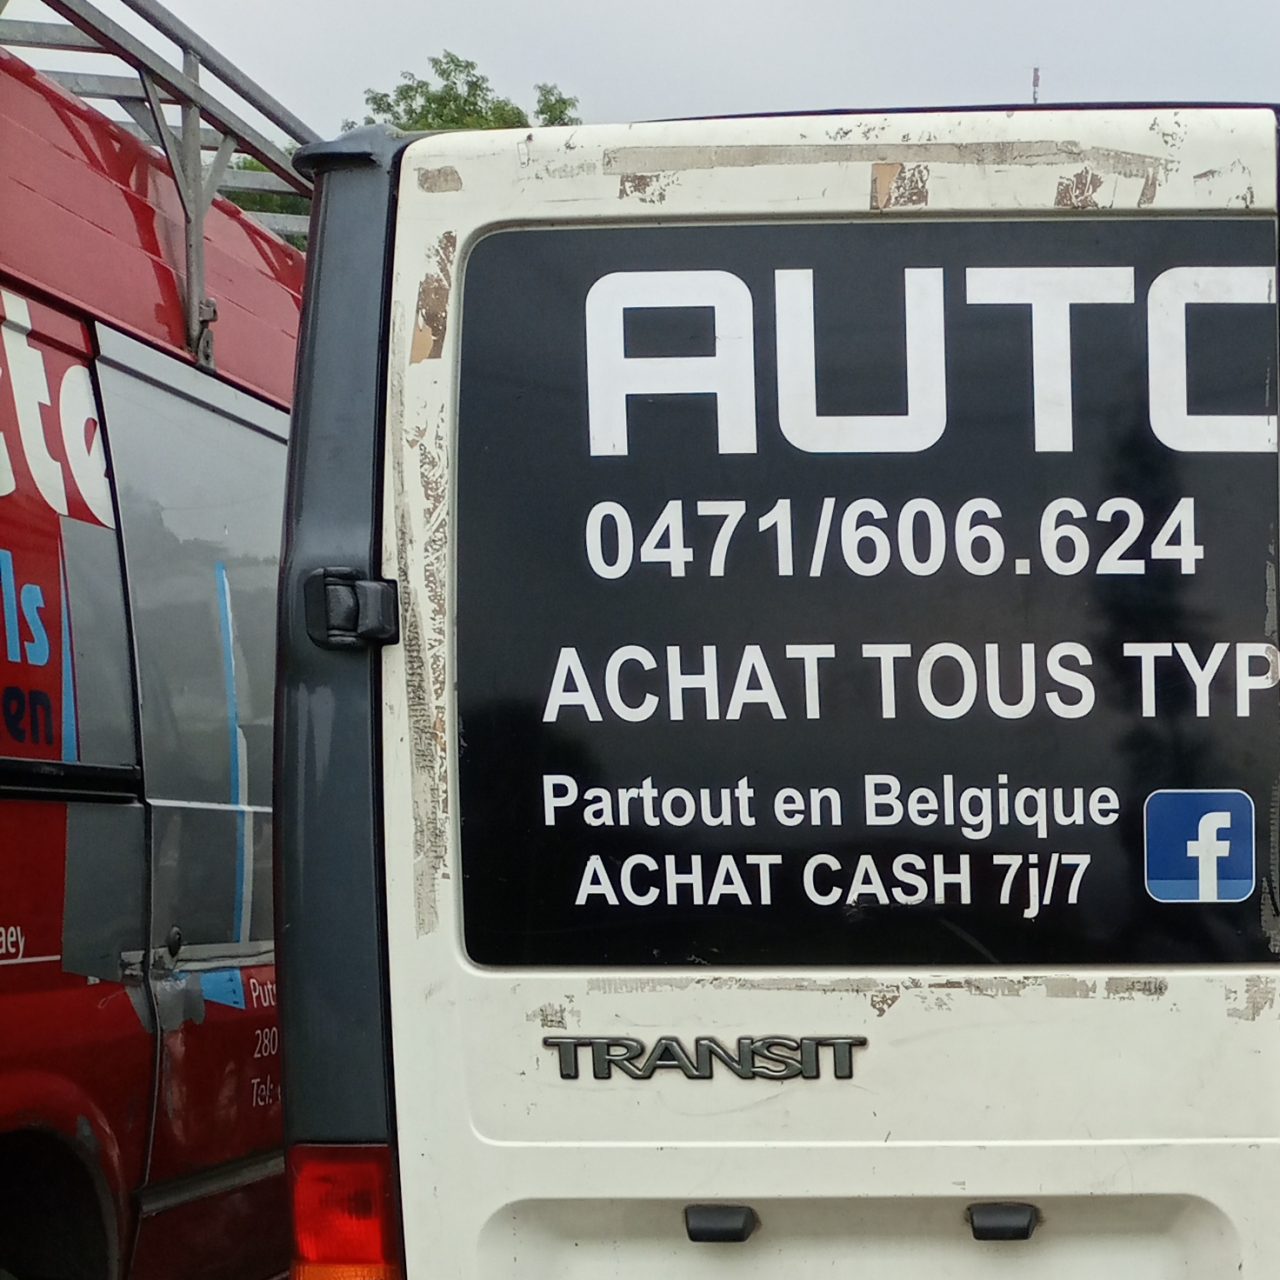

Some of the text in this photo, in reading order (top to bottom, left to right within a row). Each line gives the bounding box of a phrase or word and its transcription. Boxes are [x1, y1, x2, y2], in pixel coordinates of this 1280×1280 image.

[585, 497, 1204, 579] 0471/606.624
[542, 643, 837, 722] ACHAT
[862, 642, 1096, 720] TOUS
[541, 774, 1121, 840] Partout en Belgique
[574, 853, 1092, 920] ACHAT CASH 7j/7
[543, 1036, 868, 1080] TRANSIT
